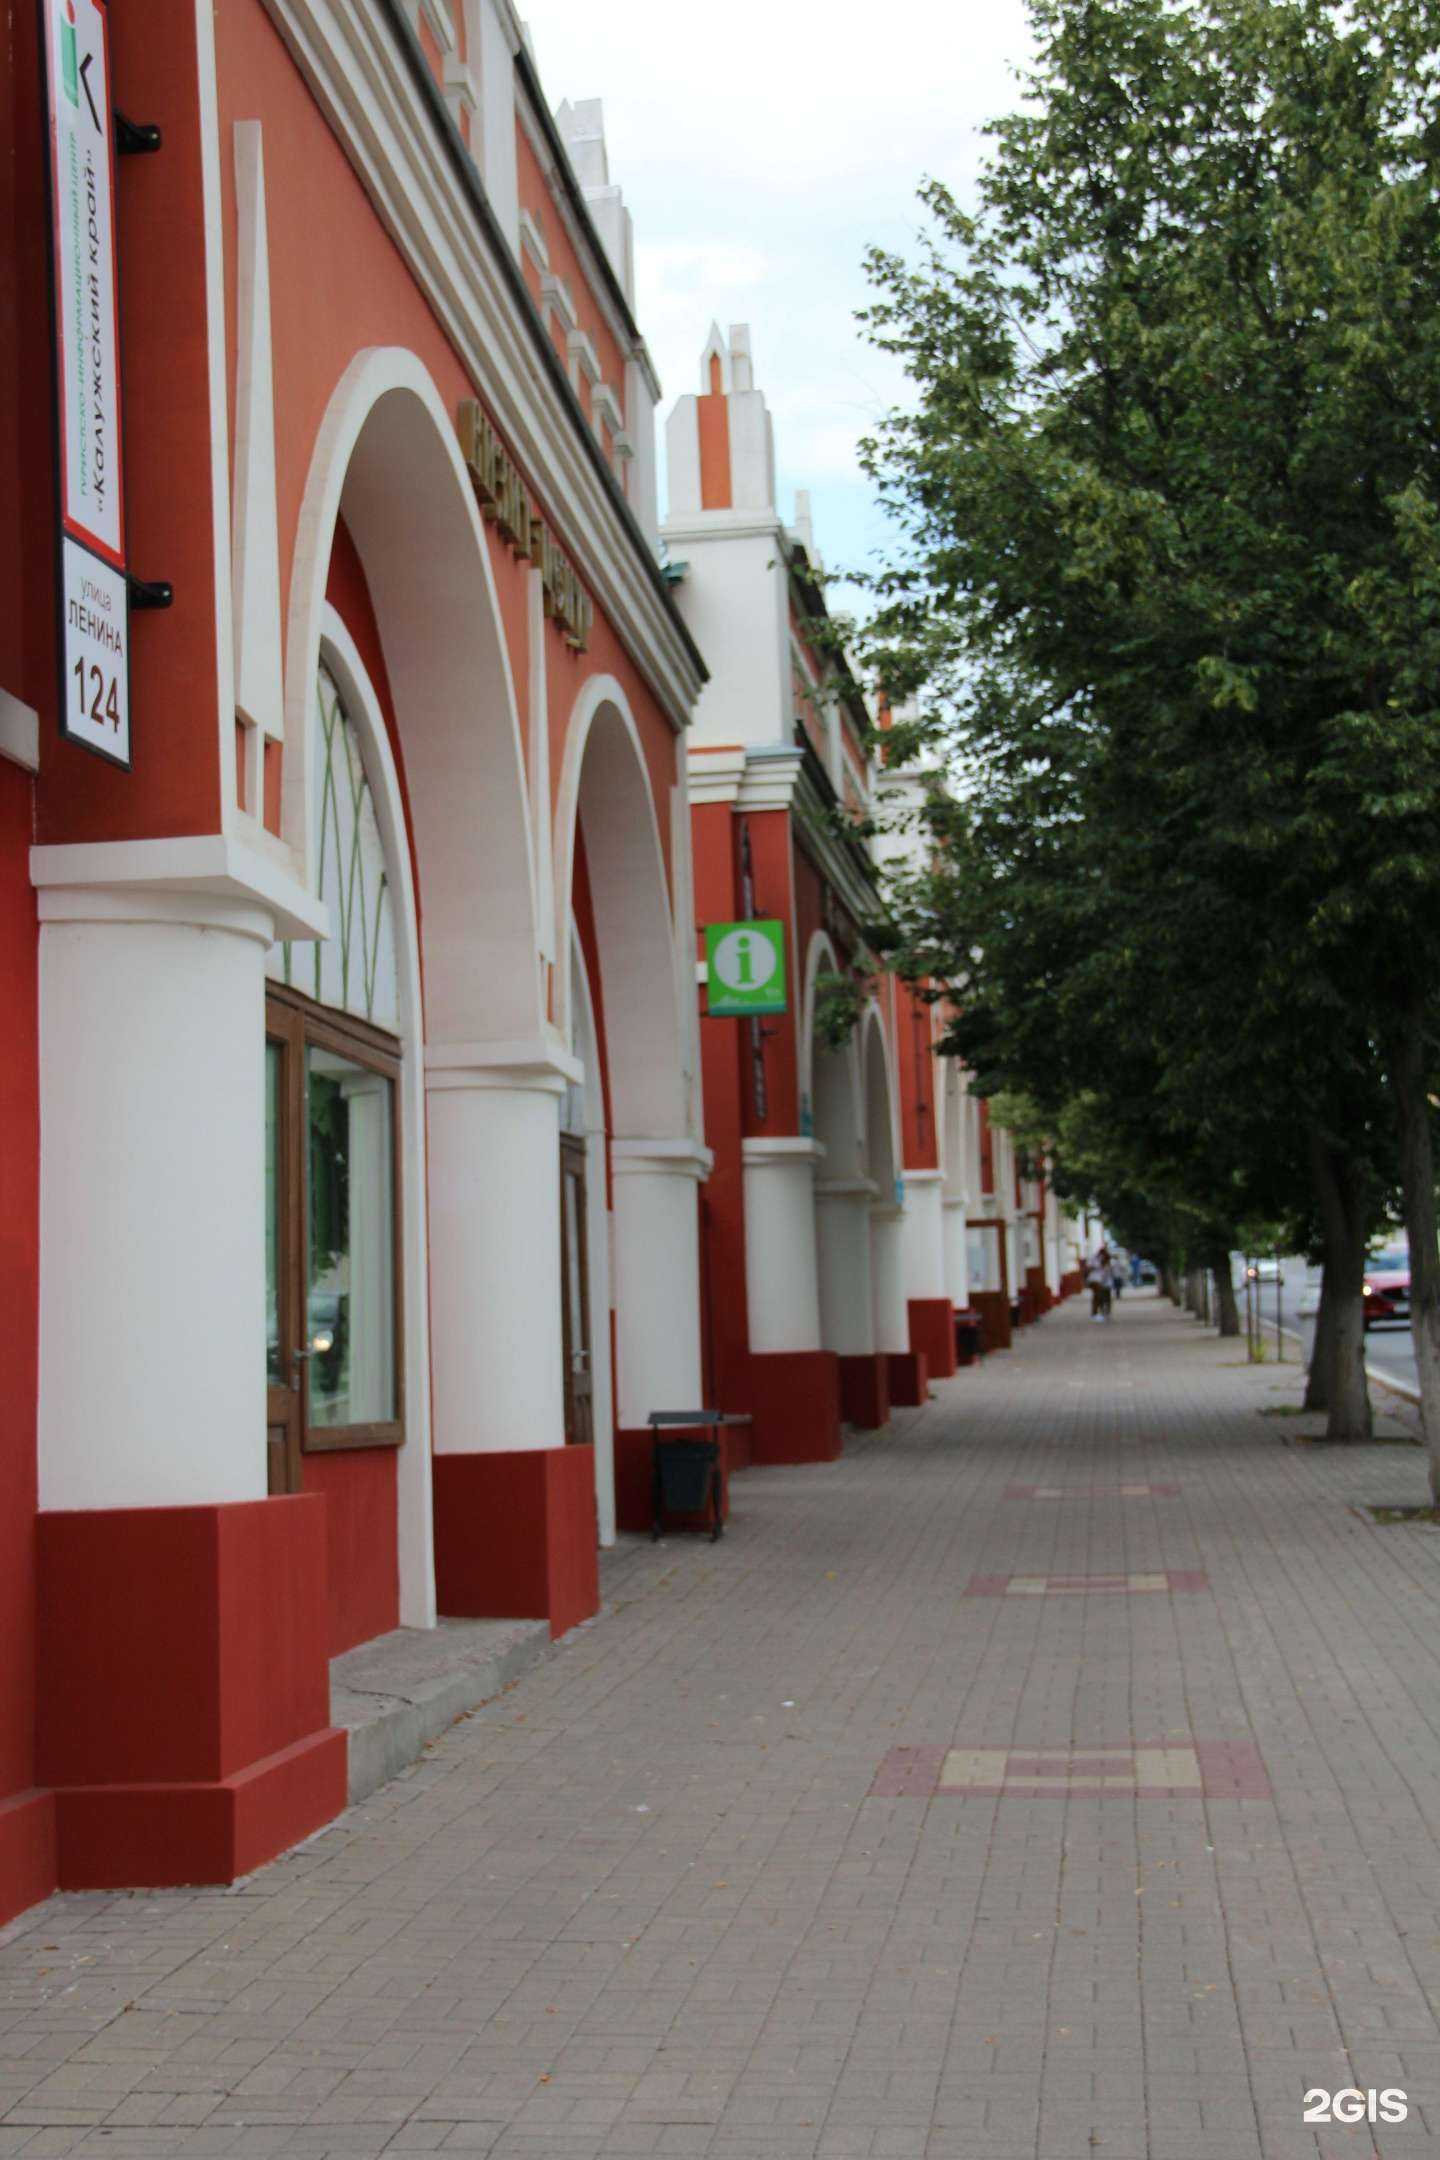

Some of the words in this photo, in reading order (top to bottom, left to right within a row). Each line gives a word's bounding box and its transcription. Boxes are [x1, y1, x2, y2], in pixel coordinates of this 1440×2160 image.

[80, 576, 112, 612] улица
[69, 599, 123, 658] ЛЕНИНА
[74, 656, 120, 734] 124
